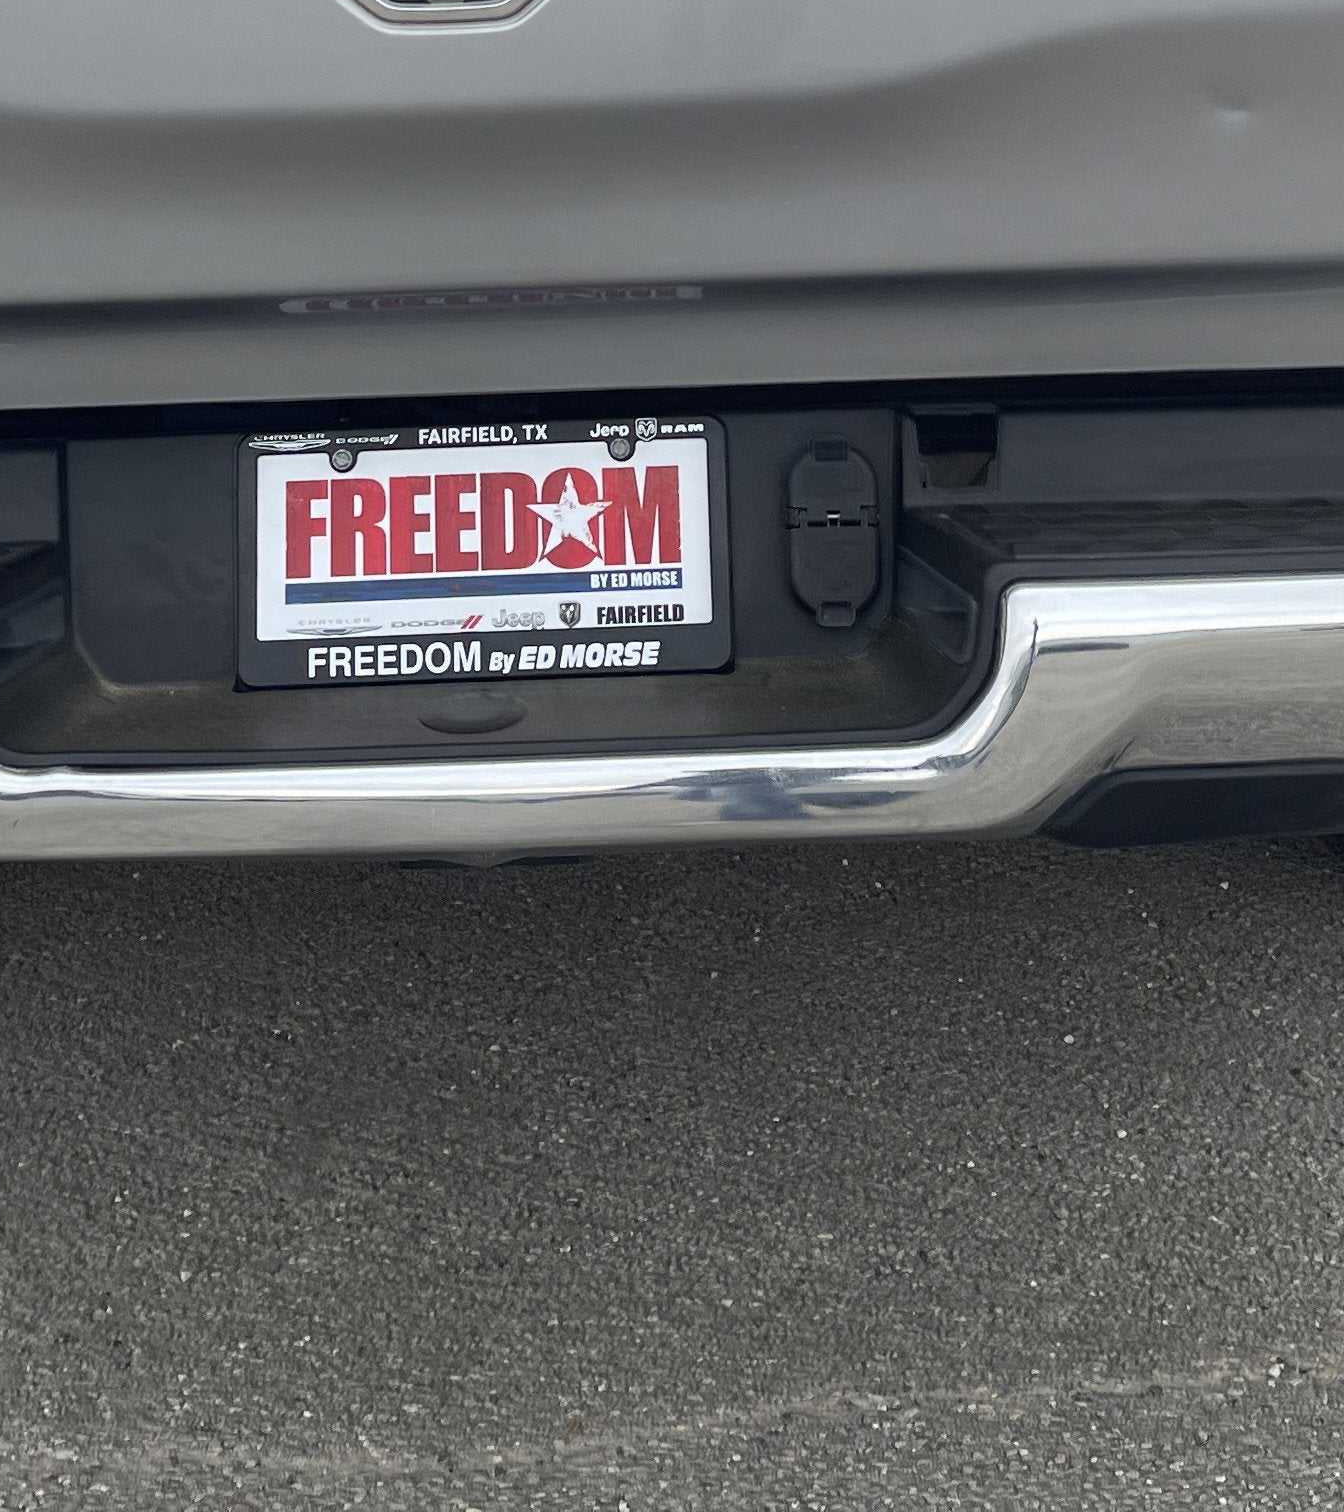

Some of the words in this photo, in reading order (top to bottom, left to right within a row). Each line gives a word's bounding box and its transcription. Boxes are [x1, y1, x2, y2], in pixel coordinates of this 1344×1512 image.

[418, 424, 518, 445] FAIRFIELD,
[522, 423, 549, 441] TX
[660, 423, 704, 434] RAM
[285, 465, 683, 580] FREEDOM
[590, 574, 608, 589] BY
[611, 573, 628, 588] ED
[630, 570, 679, 587] MORSE
[491, 609, 546, 630] Jeep
[596, 603, 685, 625] FAIRFIELD
[308, 640, 482, 679] FREEDOM
[489, 651, 516, 675] By
[518, 644, 556, 671] ED
[559, 640, 661, 670] MORSE
